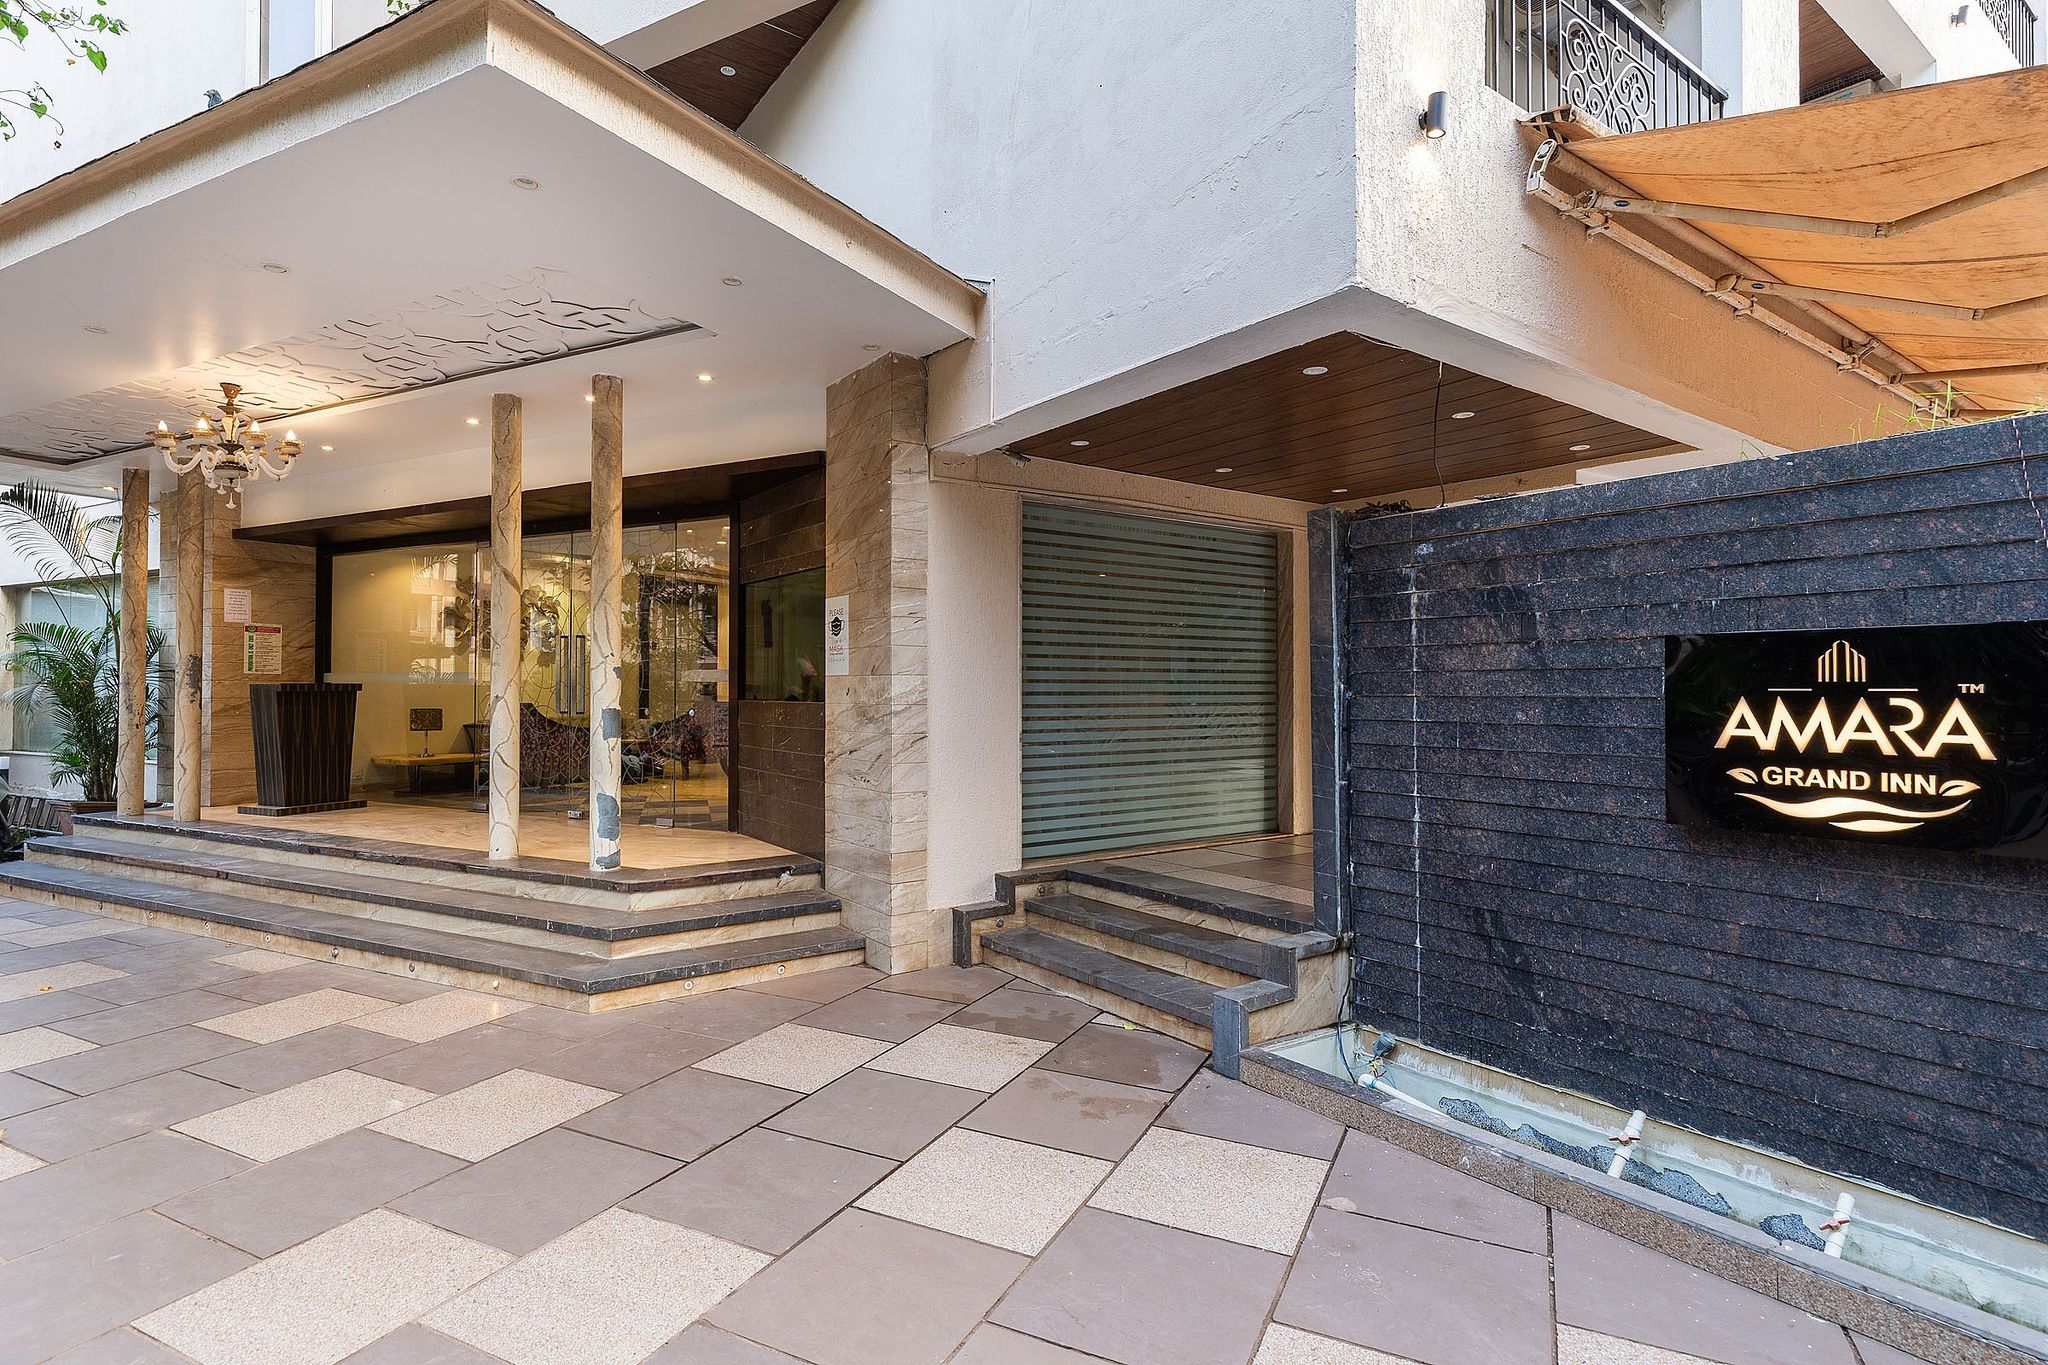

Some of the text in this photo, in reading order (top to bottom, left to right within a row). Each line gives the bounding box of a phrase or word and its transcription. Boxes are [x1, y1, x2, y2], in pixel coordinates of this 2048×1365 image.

[829, 608, 844, 617] PLEASE
[829, 645, 844, 653] MASK
[1714, 696, 1997, 760] AMARA
[1762, 766, 1937, 795] GRAND INN
